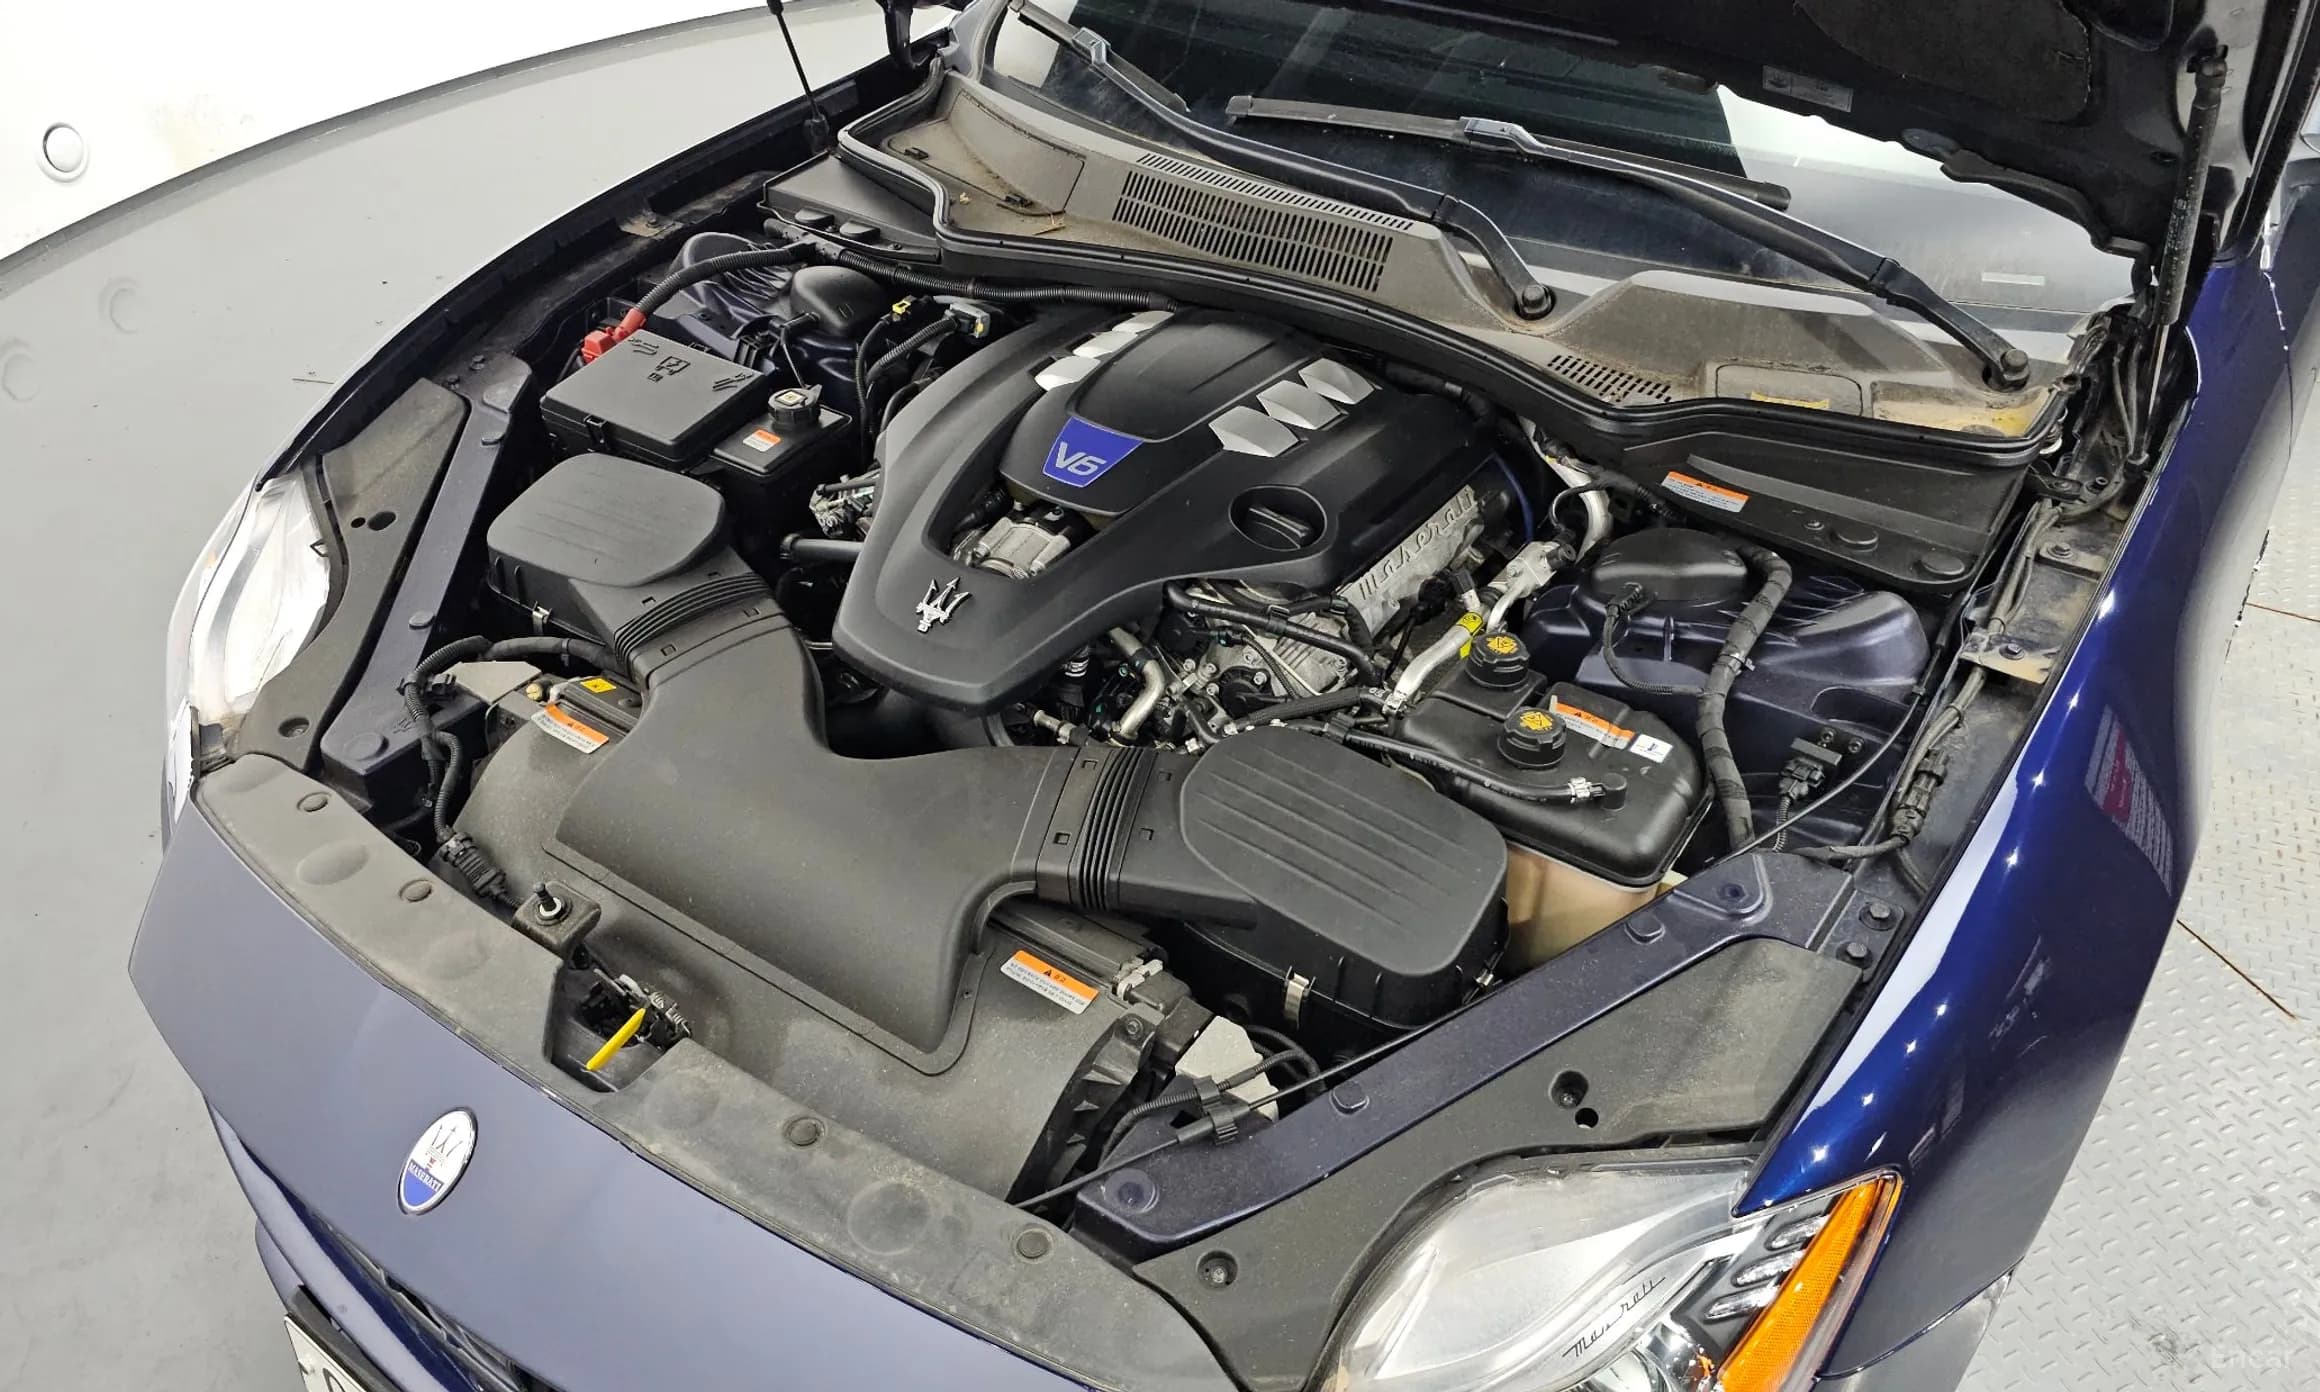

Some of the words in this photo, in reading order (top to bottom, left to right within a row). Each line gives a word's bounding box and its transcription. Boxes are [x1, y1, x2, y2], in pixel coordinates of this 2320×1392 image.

[1056, 441, 1107, 476] V6
[408, 1162, 442, 1192] MASERATI
[1562, 1277, 1667, 1358] Masrati
